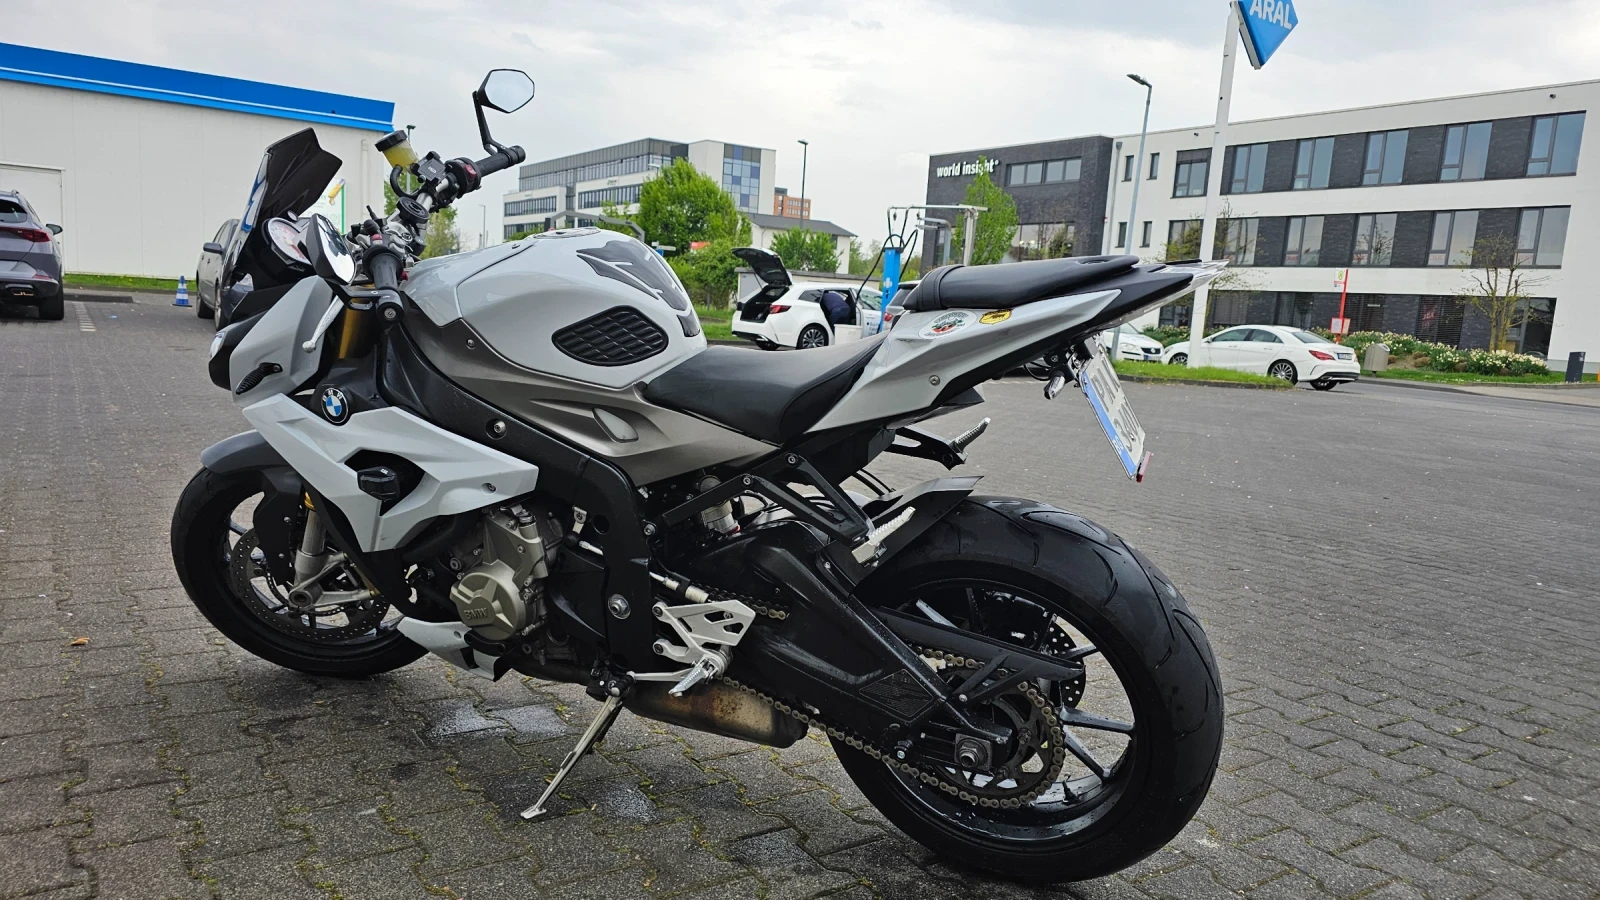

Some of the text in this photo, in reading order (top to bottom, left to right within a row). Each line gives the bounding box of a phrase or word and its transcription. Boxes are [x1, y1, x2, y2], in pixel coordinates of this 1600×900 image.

[1249, 0, 1292, 30] ARAL
[937, 162, 961, 178] world
[322, 389, 343, 402] BMW
[463, 607, 488, 620] BMW
